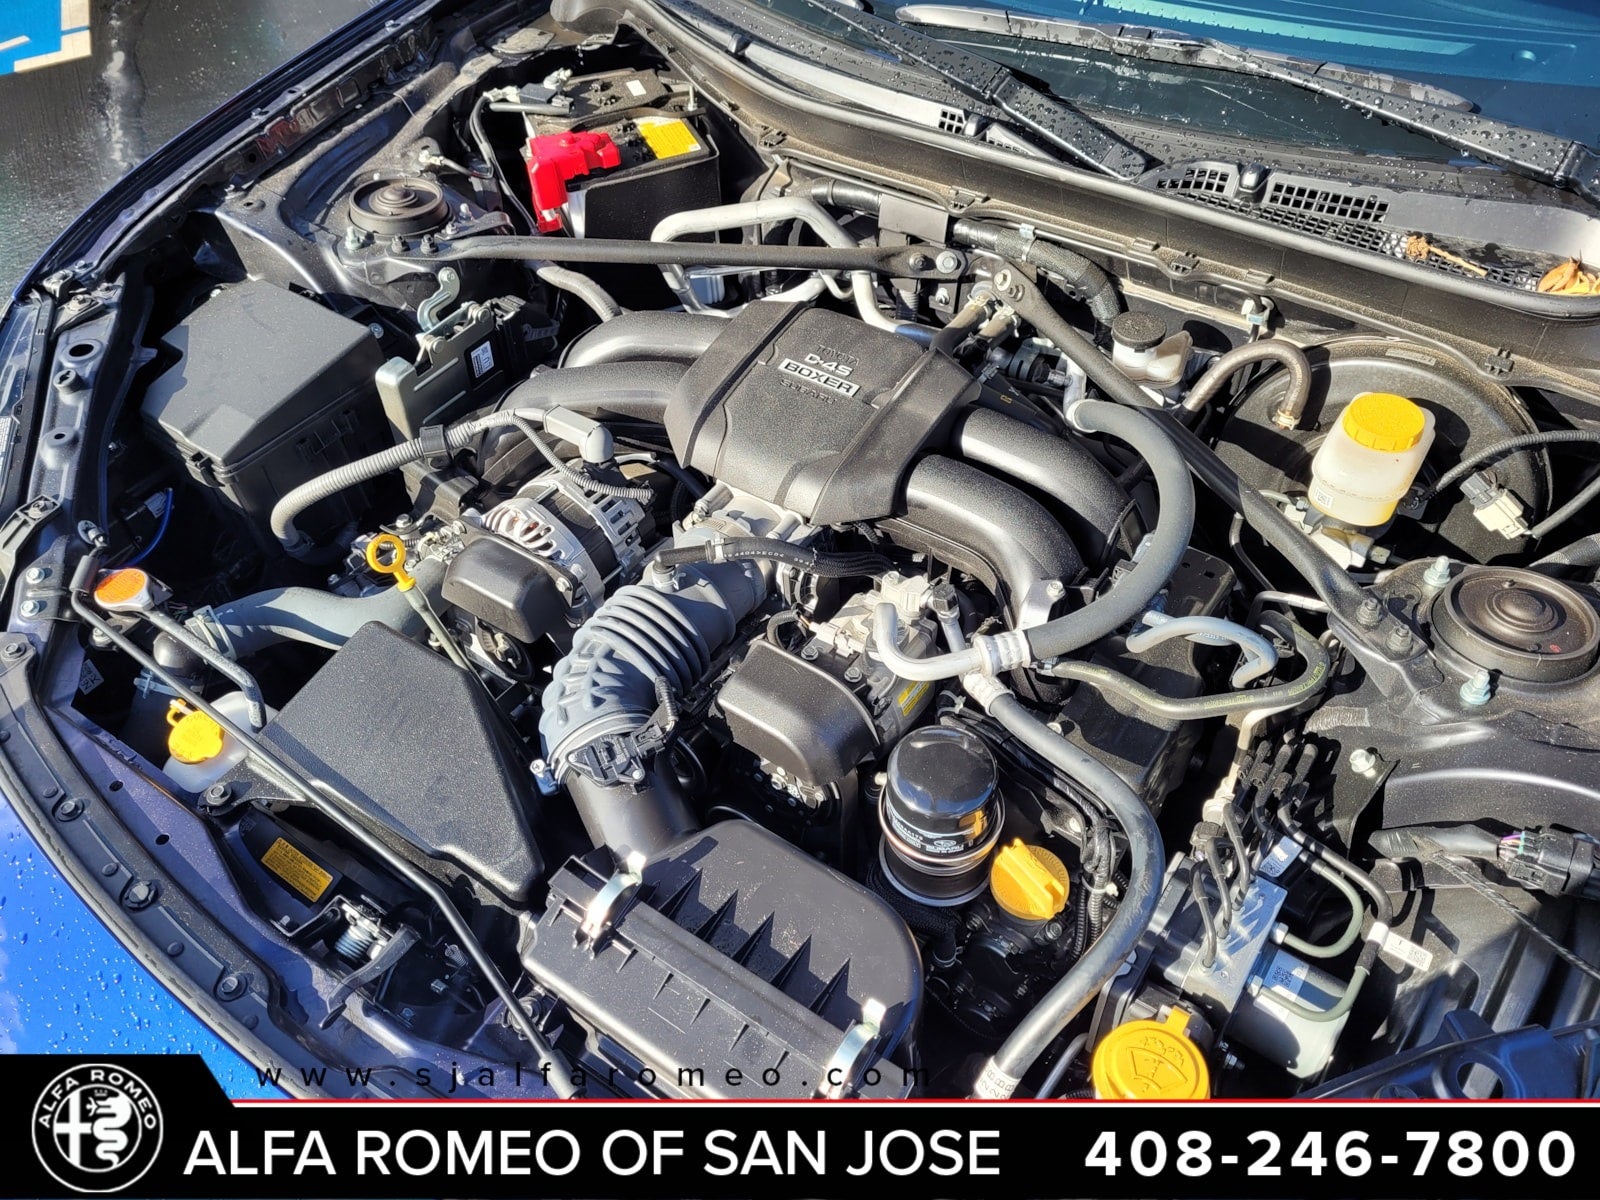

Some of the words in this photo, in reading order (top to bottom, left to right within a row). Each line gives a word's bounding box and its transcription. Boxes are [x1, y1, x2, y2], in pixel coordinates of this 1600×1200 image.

[816, 345, 860, 366] TOYOTA
[783, 361, 854, 393] BOXER
[780, 379, 838, 405] SUBARU
